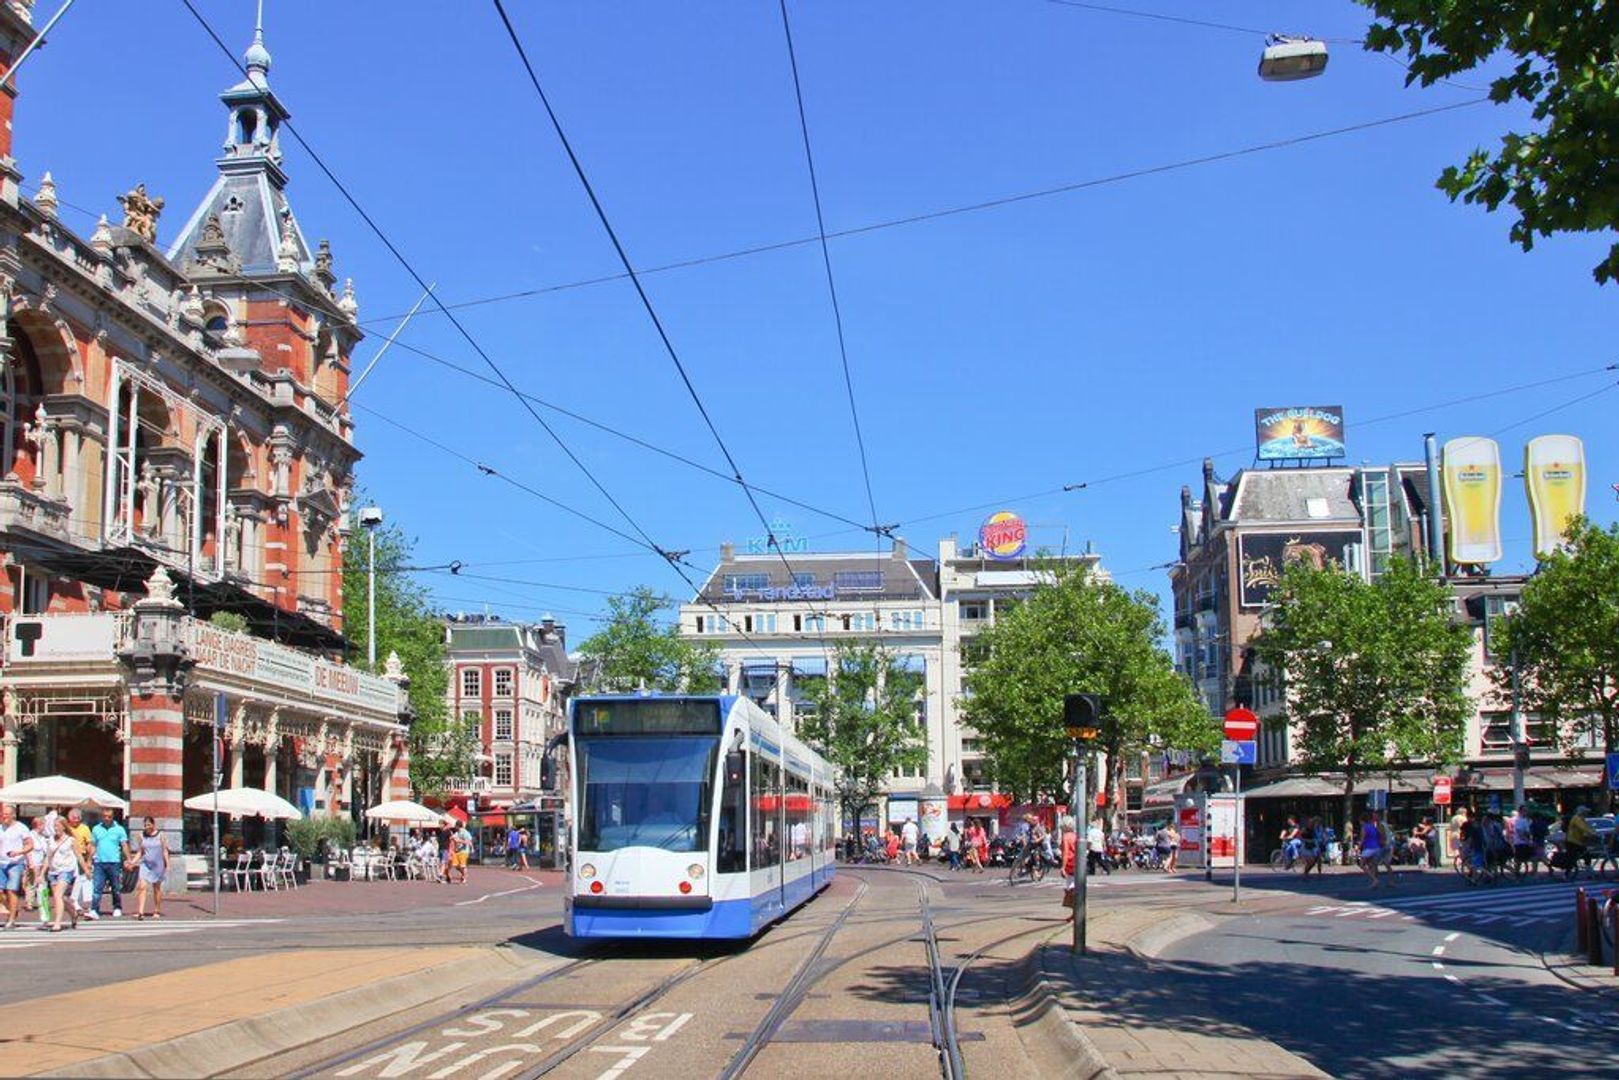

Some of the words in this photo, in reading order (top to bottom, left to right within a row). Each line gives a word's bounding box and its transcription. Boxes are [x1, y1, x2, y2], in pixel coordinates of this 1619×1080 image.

[1261, 412, 1285, 426] THE
[1286, 408, 1341, 425] BULLDOG
[986, 528, 1025, 553] KING
[314, 665, 327, 688] DE
[442, 1009, 696, 1041] BUS
